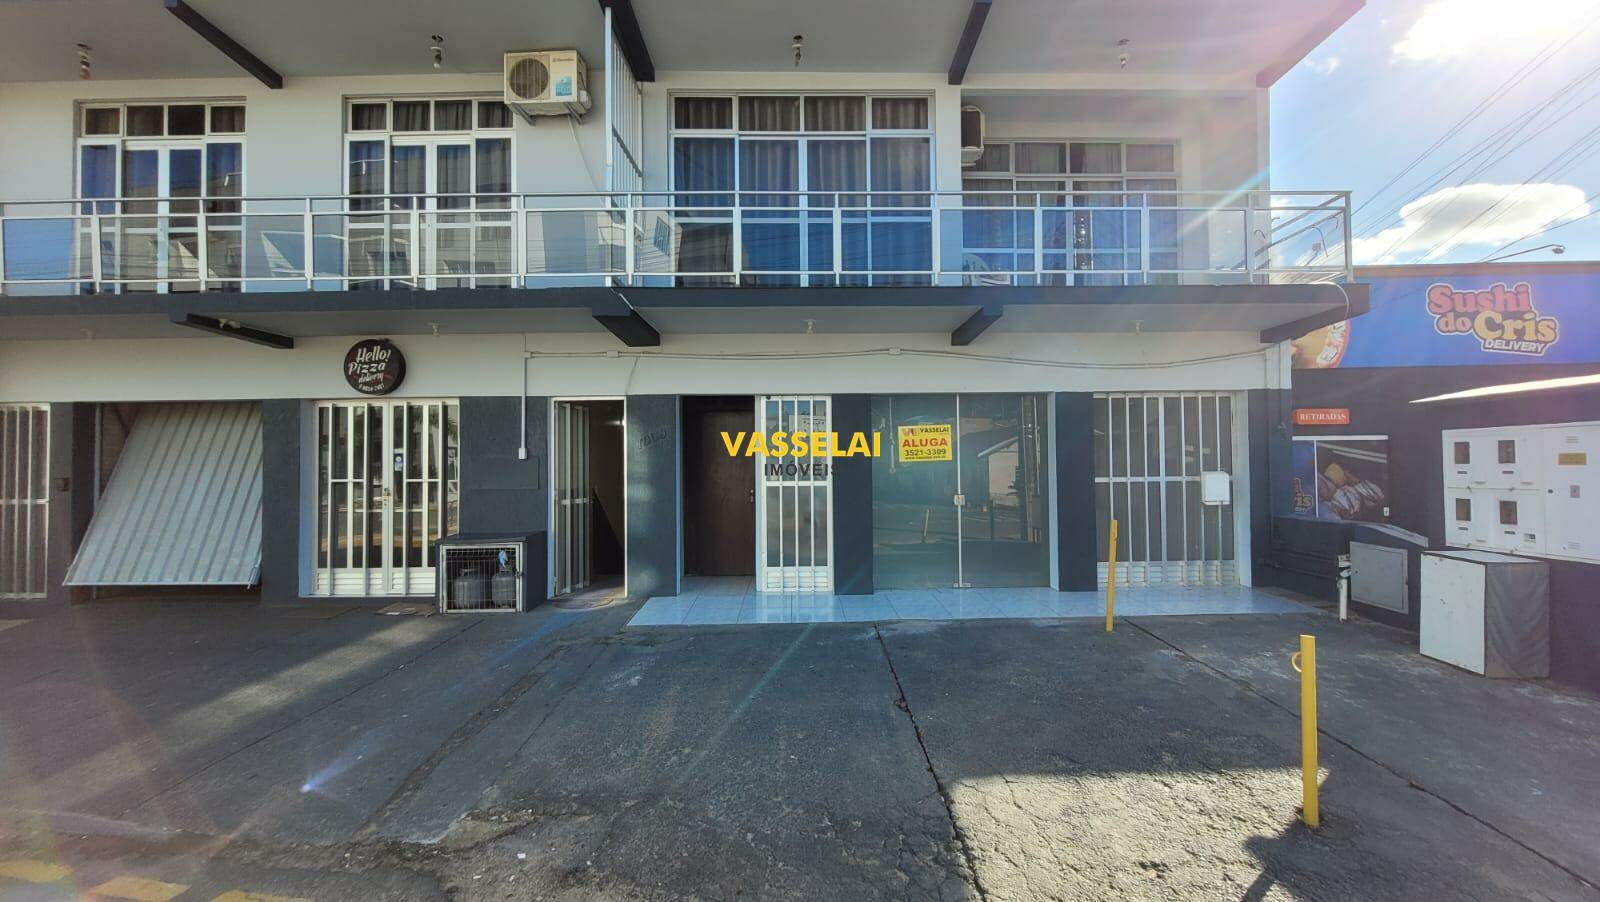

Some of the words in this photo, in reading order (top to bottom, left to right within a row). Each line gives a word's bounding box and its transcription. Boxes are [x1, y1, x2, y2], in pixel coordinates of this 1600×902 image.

[1427, 283, 1532, 315] Sushi
[1437, 311, 1473, 333] do
[1473, 310, 1557, 342] Cris
[1485, 339, 1546, 353] DELIVERY
[356, 345, 391, 362] Hello!
[348, 361, 386, 375] Pizza
[1299, 413, 1347, 421] RETIRADAS
[902, 437, 948, 448] ALUGA
